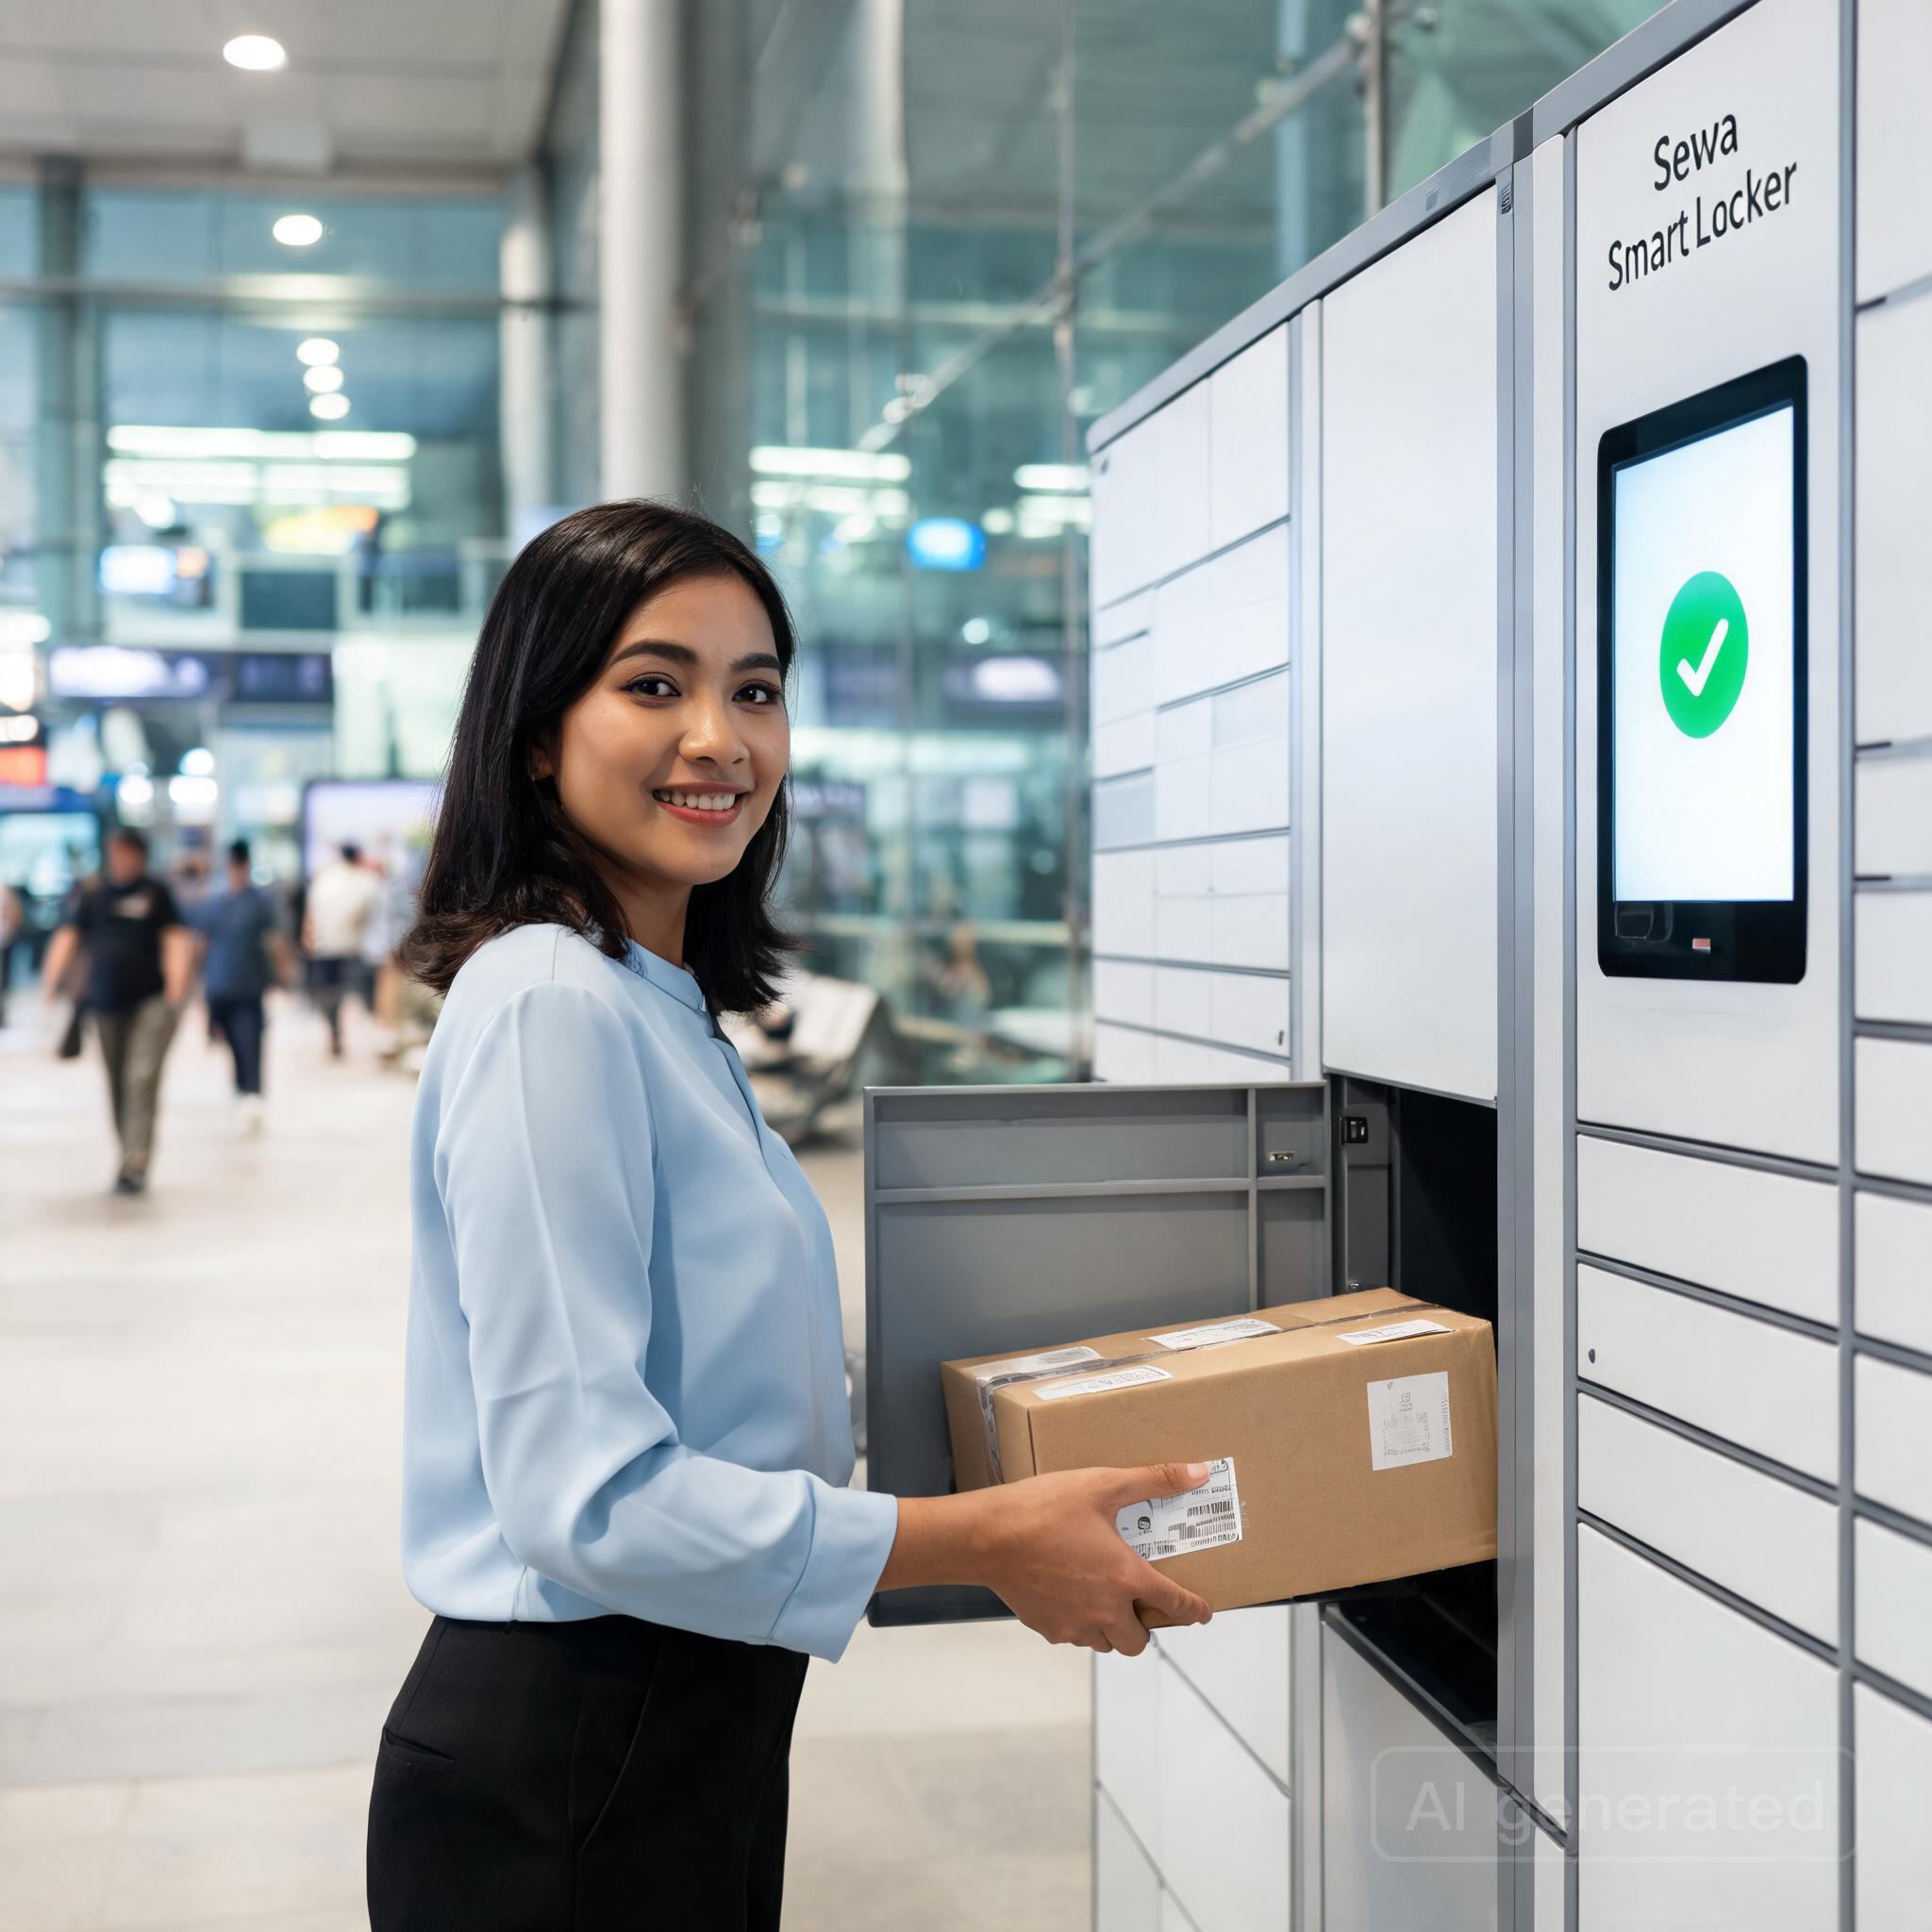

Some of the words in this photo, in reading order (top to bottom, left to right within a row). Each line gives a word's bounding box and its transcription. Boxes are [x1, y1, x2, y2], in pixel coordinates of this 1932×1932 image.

[1654, 113, 1739, 192] Sewa
[1607, 209, 1690, 291] Smart
[1695, 161, 1797, 249] Locker
